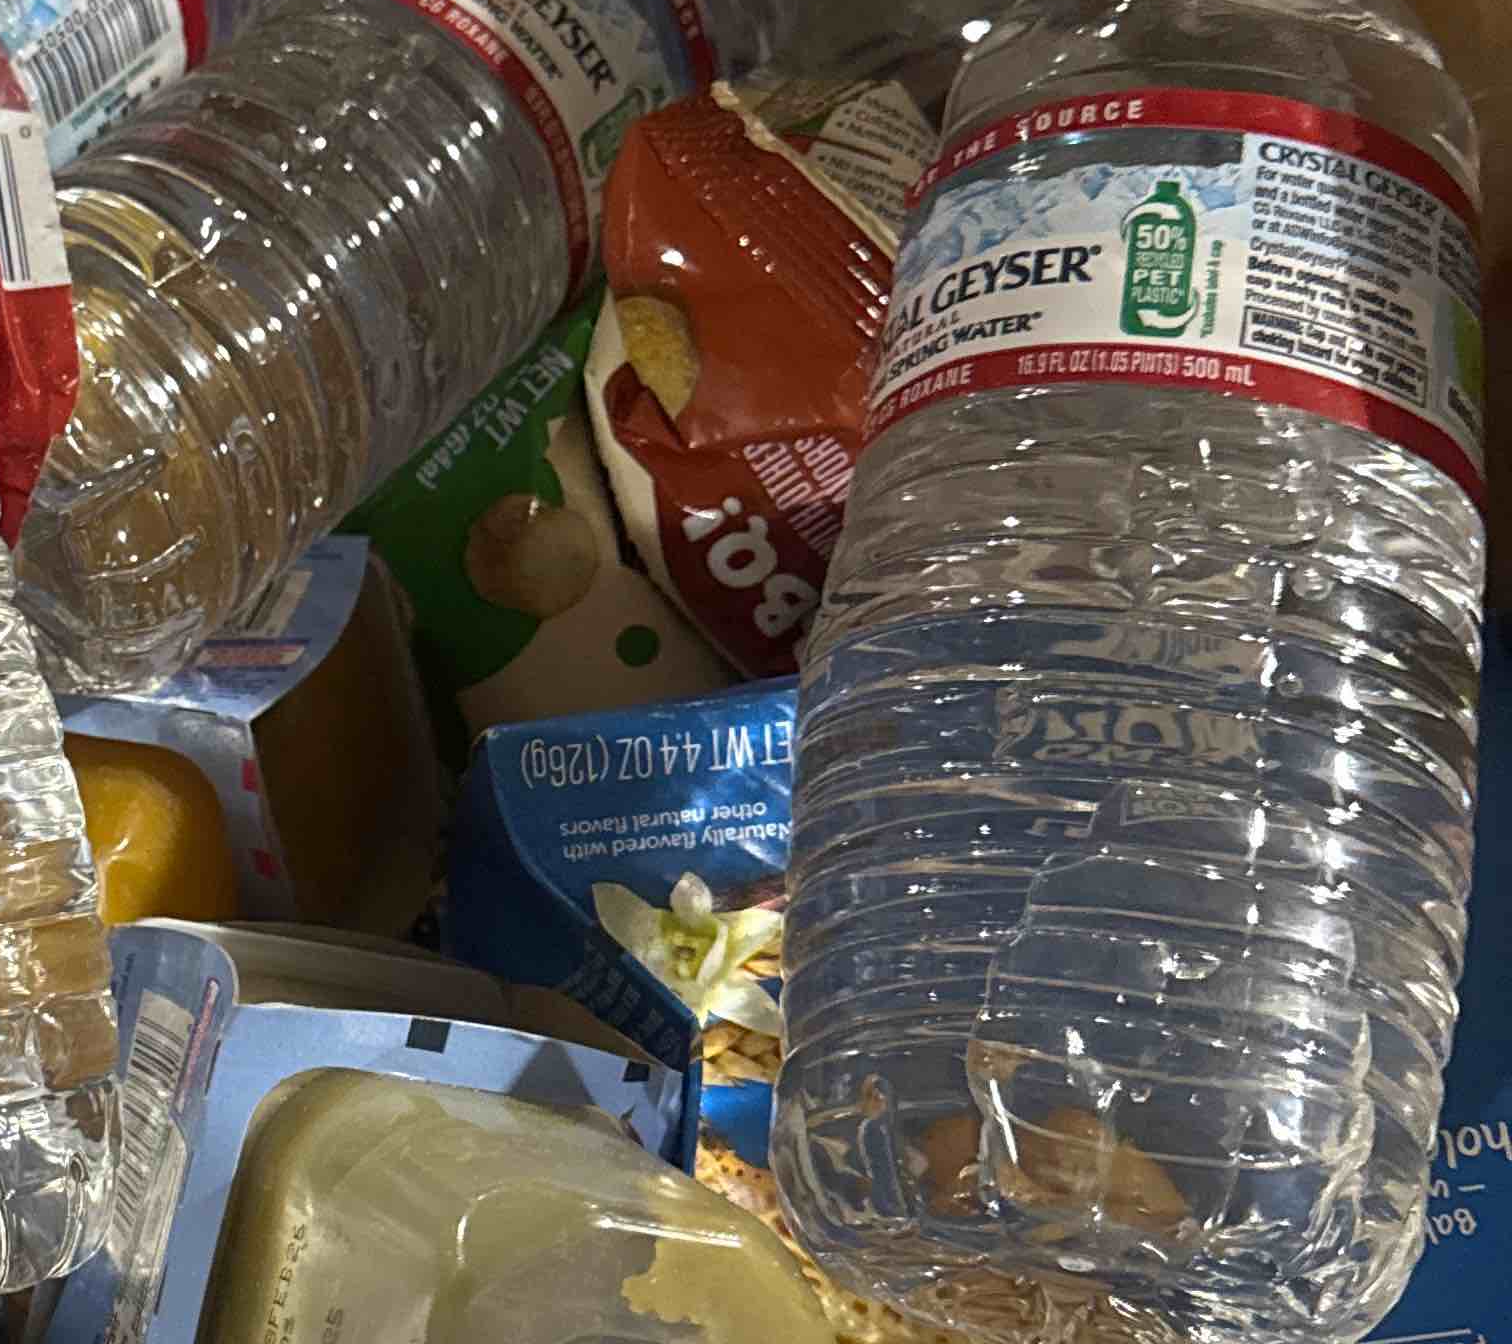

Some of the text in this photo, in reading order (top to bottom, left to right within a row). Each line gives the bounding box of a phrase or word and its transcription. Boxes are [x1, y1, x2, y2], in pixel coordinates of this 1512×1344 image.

[952, 97, 1147, 168] THE SOURCE
[1258, 142, 1361, 186] CRYSTAL
[1135, 224, 1187, 252] 50%
[931, 246, 1092, 318] GEYSER
[1132, 269, 1184, 287] PET
[951, 313, 1033, 345] WATER
[900, 362, 975, 410] ROXANE
[1017, 351, 1046, 374] 16.9
[1048, 351, 1067, 372] FL
[1069, 350, 1090, 372] OZ
[1181, 356, 1218, 380] 500
[1224, 364, 1256, 387] mL
[521, 735, 609, 789] (126g)
[617, 738, 653, 781] OZ
[661, 736, 702, 777] 4.4
[708, 725, 755, 772] WT
[559, 801, 767, 838] other natural flavors
[562, 839, 608, 860] with
[611, 831, 698, 855] flavored
